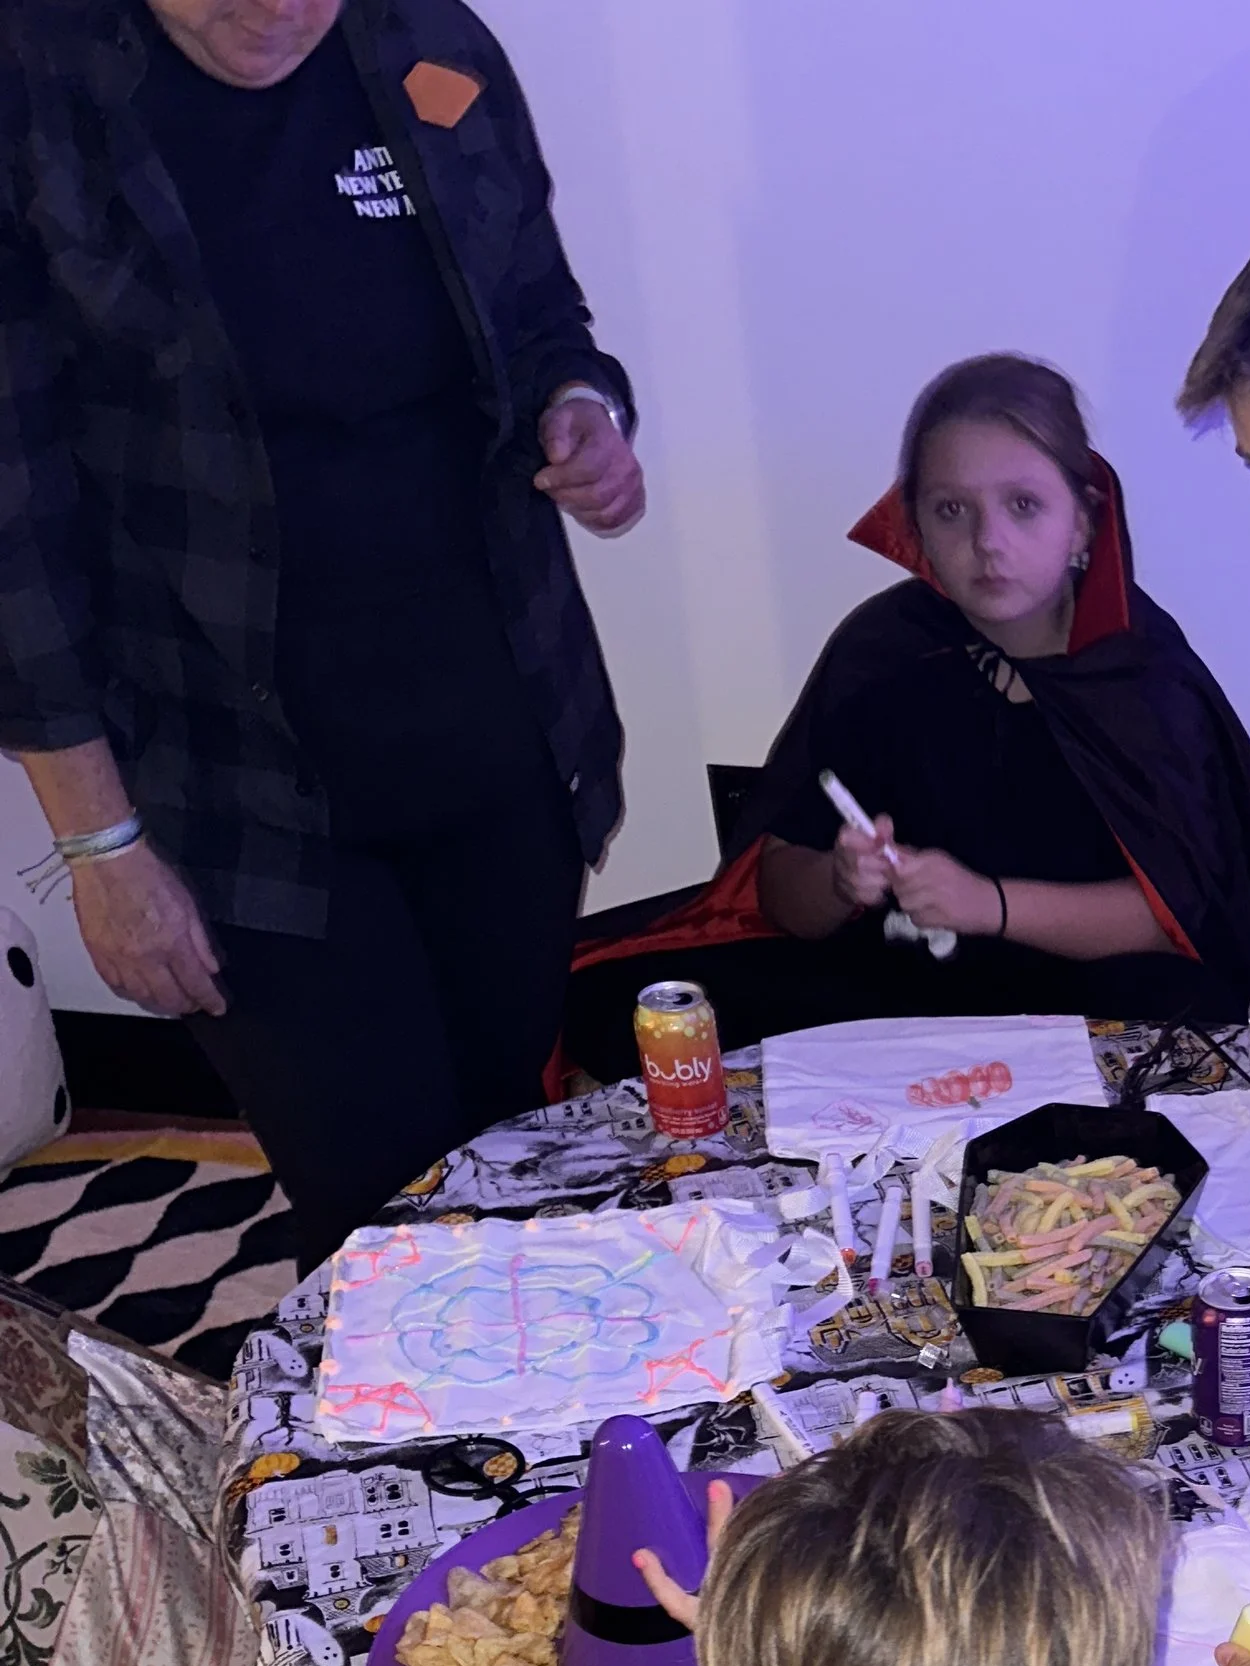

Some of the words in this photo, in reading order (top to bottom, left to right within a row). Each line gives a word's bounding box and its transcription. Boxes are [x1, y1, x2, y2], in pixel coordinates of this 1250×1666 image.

[354, 146, 394, 172] ANTI
[334, 173, 378, 196] NEW
[353, 197, 401, 218] NEW
[644, 1053, 712, 1082] bubly
